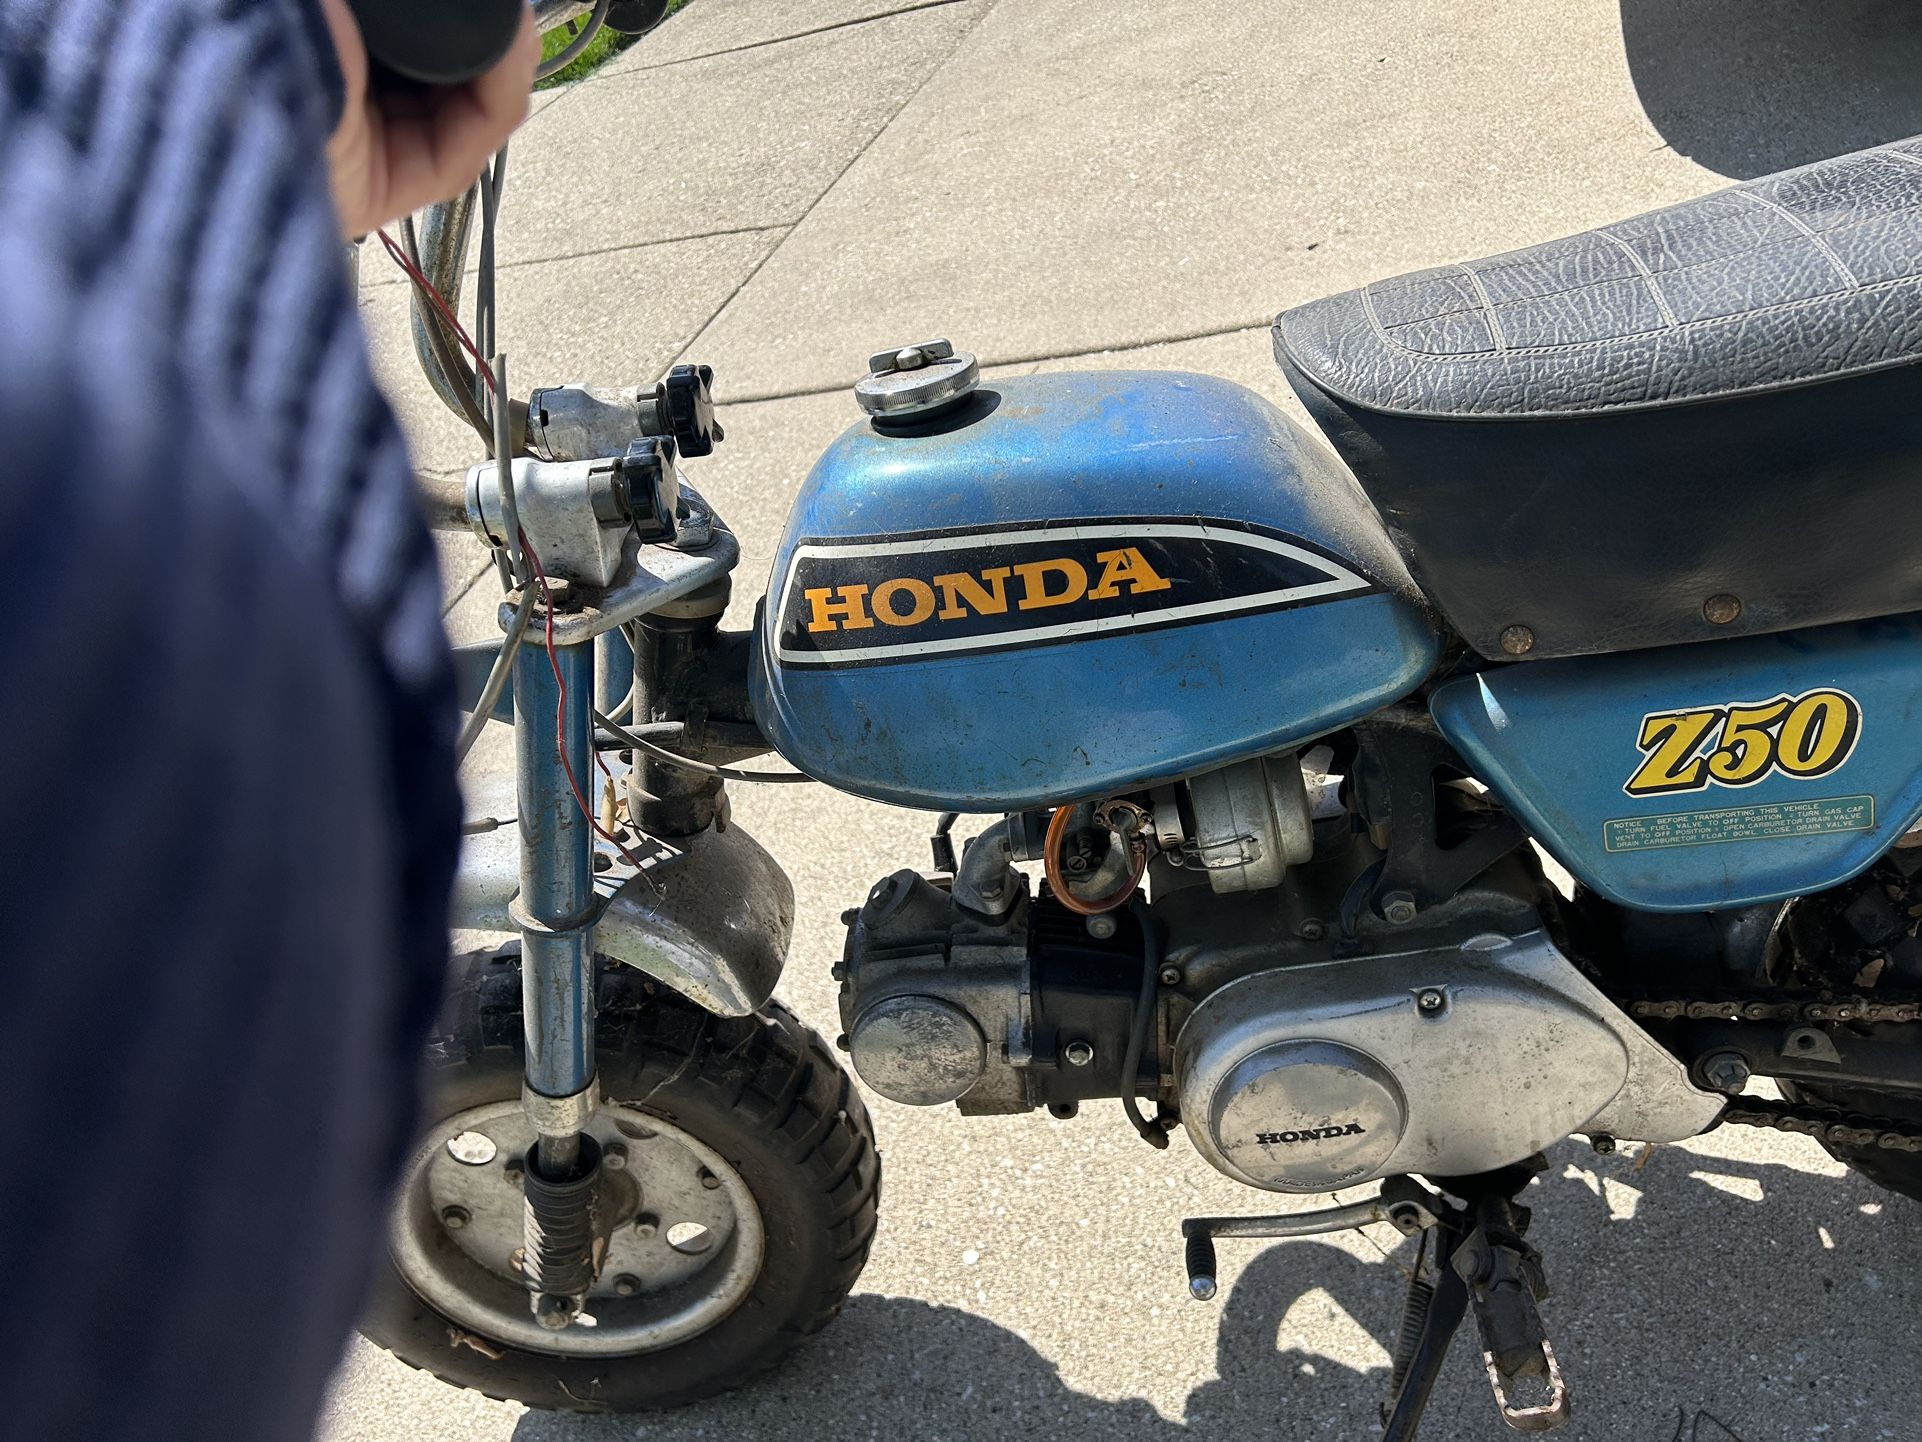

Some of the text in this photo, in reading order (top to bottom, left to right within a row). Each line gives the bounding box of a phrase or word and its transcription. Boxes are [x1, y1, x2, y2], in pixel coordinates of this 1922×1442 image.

[804, 546, 1171, 633] HONDA
[1624, 689, 1861, 796] Z50
[1657, 817, 1689, 825] BEFORE
[1694, 811, 1755, 820] TRANSPORTING
[1783, 804, 1820, 812] VEHICLE
[1676, 821, 1703, 829] VALVE
[1744, 814, 1782, 823] POSITION
[1616, 840, 1640, 848] DRAIN
[1643, 836, 1697, 845] CARBURETOR
[1701, 832, 1728, 840] FLOAT
[1796, 824, 1821, 832] DRAIN
[1675, 828, 1712, 836] POSITION
[1723, 824, 1745, 832] OPEN
[1747, 819, 1803, 829] CARBURETOR
[1805, 816, 1831, 824] DRAIN
[1256, 1123, 1366, 1145] HONDA
